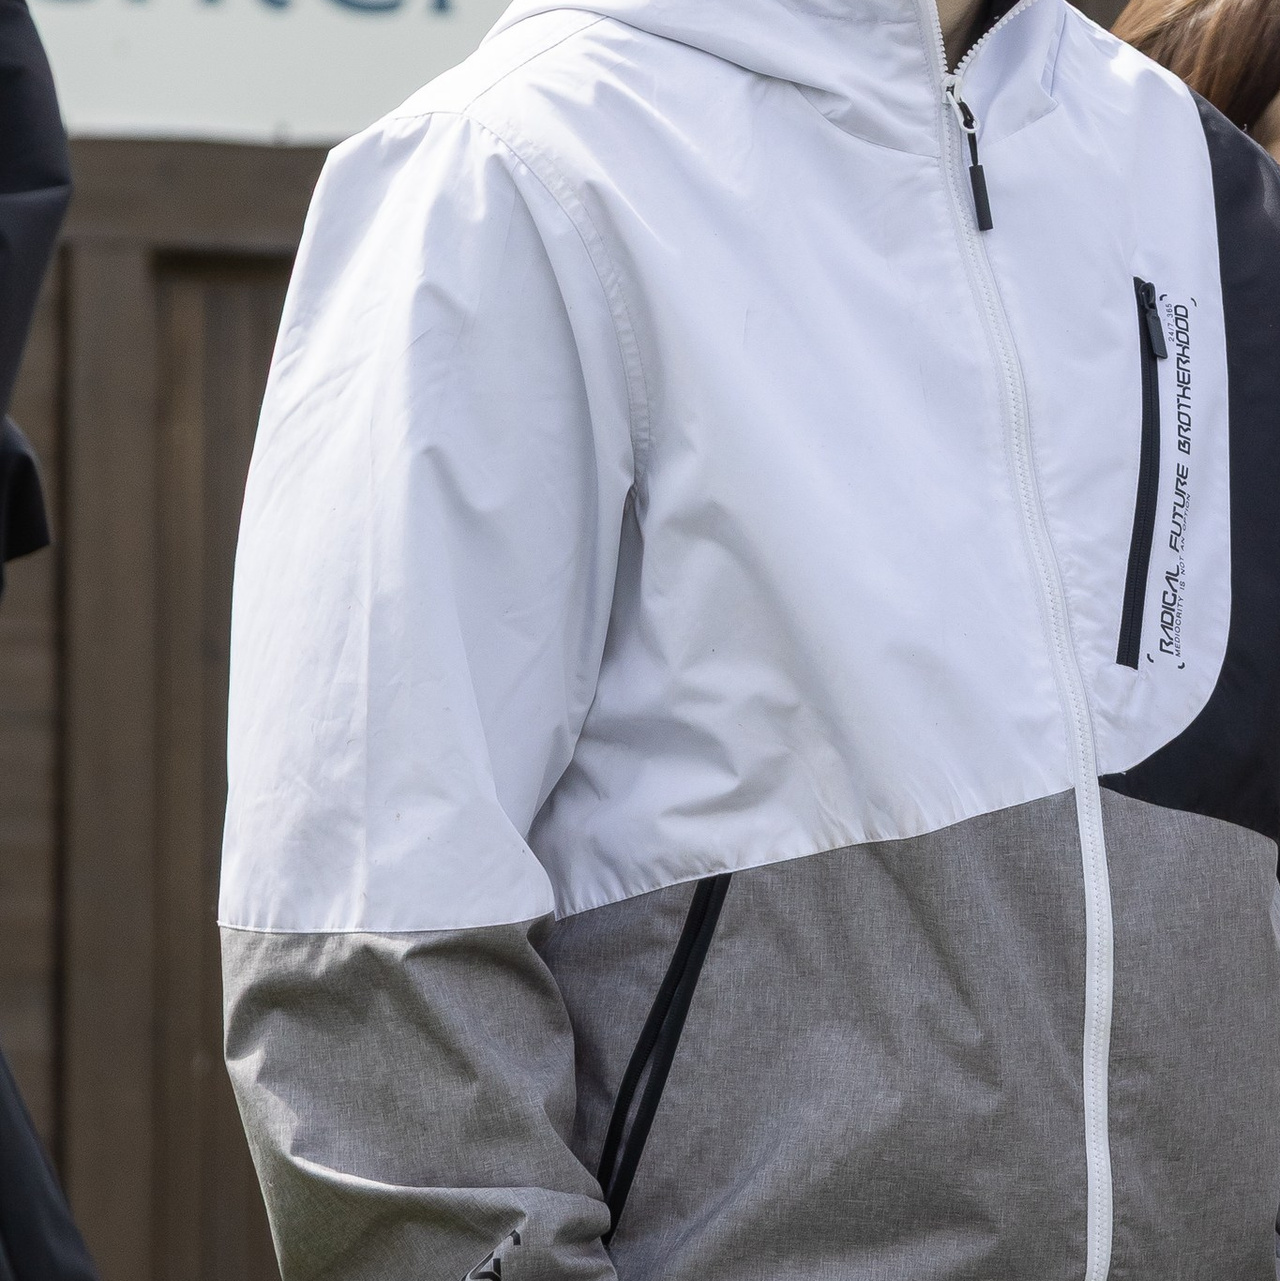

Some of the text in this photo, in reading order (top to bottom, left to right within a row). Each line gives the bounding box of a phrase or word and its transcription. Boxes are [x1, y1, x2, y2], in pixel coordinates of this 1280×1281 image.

[1159, 304, 1192, 656] RADICAL FUTURE BROTHERHOOD
[1182, 493, 1191, 532] OPTION
[1180, 536, 1186, 552] AN
[1179, 581, 1186, 591] IS
[1174, 595, 1185, 658] MEDIOCRITY
